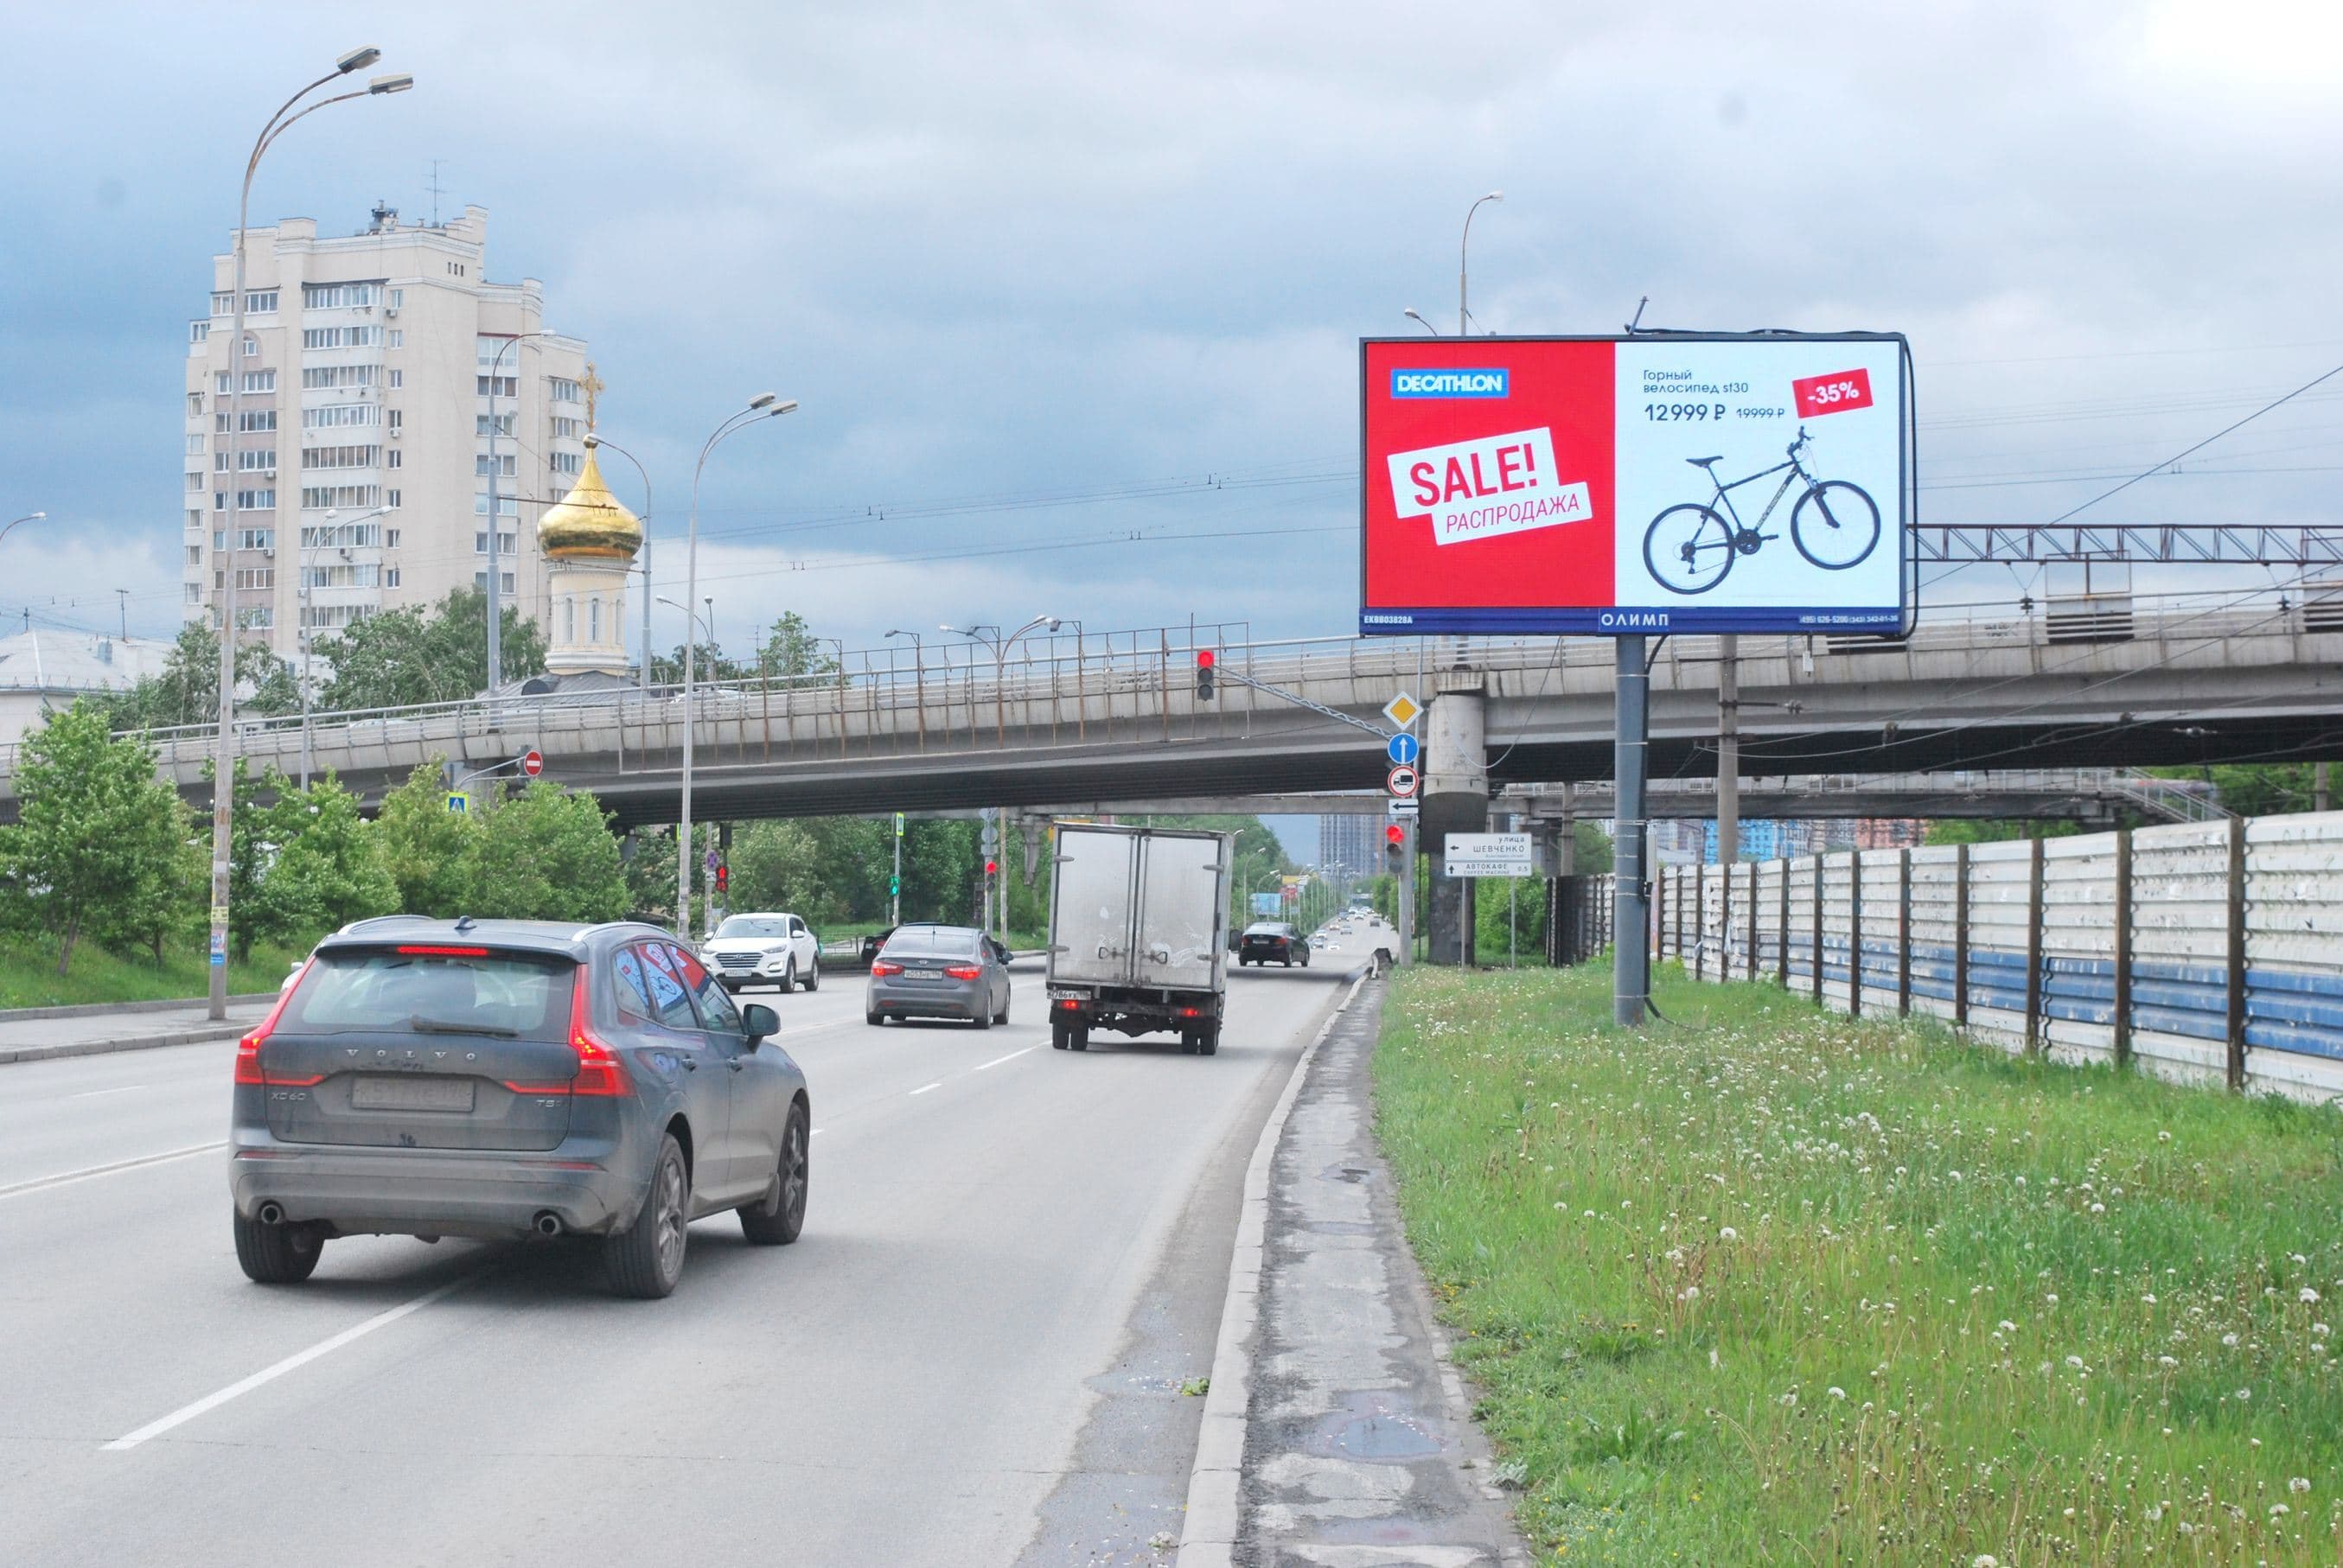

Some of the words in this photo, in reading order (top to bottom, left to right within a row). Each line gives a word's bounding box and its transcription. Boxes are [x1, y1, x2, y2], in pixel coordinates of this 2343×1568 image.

[1643, 369, 1692, 382] Горный
[1397, 374, 1503, 392] DECATHLON
[1643, 383, 1720, 394] велосипед
[1807, 381, 1860, 405] -35%
[1409, 442, 1538, 507] SALE!
[1446, 493, 1580, 534] РАСПРОДАЖА
[1600, 613, 1669, 627] ОЛИМП
[1473, 845, 1525, 853] ШЕВЧЕНКО
[347, 1049, 476, 1061] VOLVO
[271, 1092, 307, 1100] XC60
